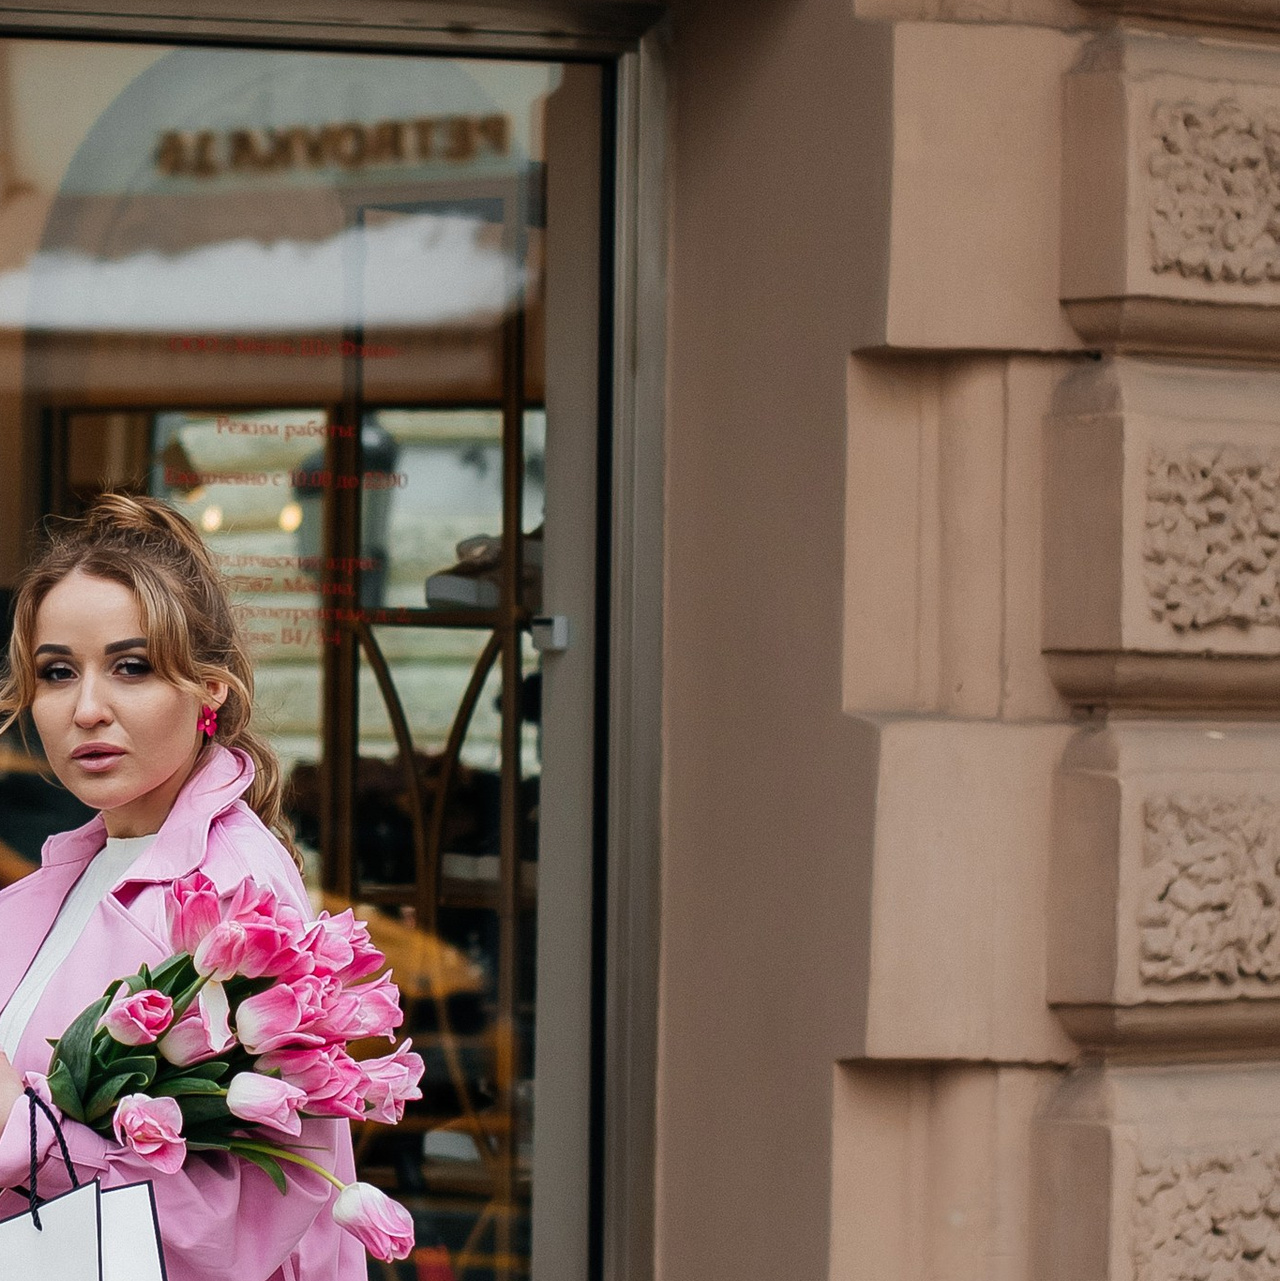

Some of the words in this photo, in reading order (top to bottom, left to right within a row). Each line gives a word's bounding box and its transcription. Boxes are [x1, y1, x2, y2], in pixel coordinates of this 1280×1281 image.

[216, 417, 278, 435] Режим
[164, 467, 267, 486] Ежедневно
[334, 475, 359, 489] до
